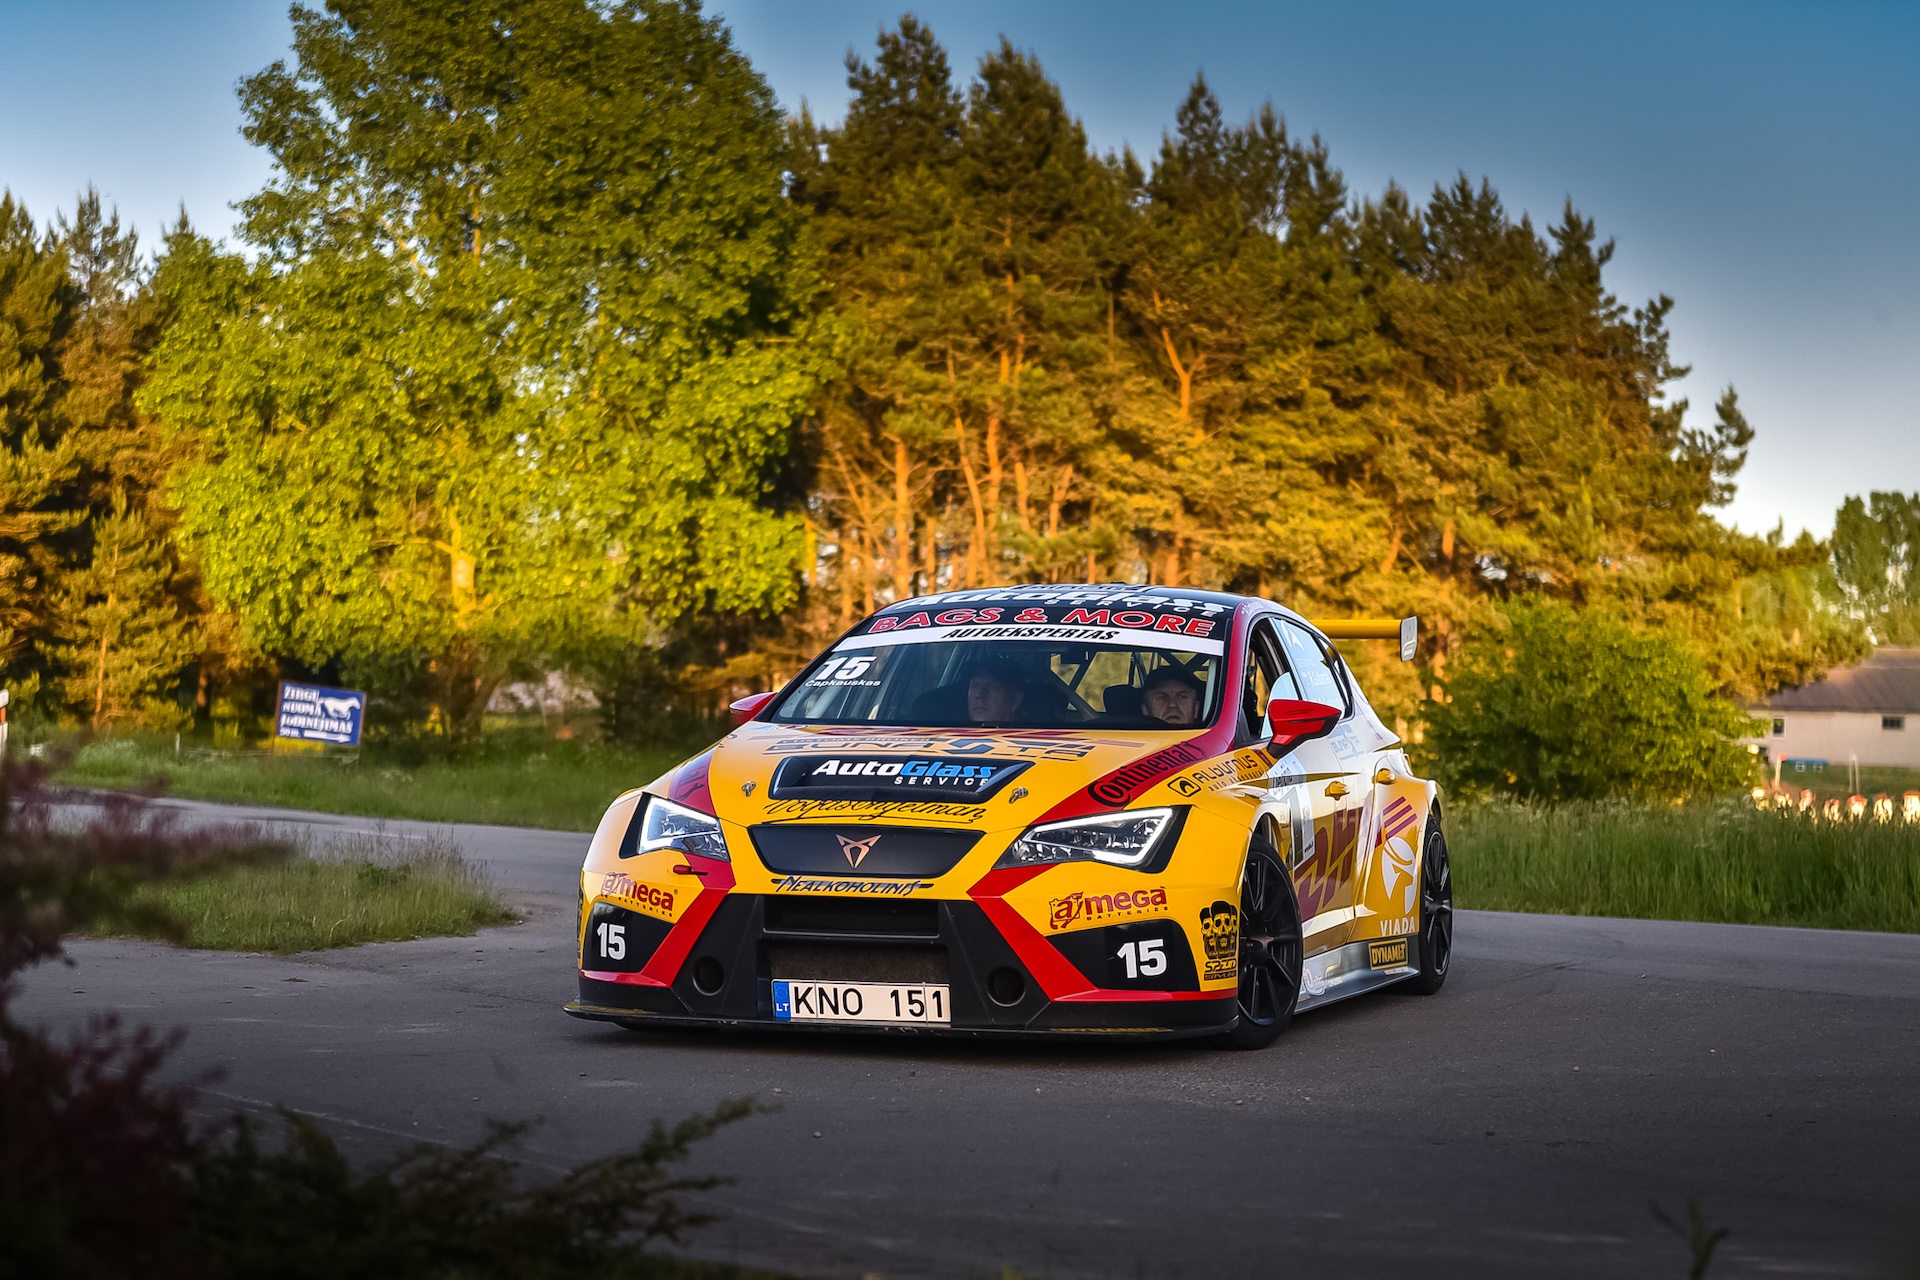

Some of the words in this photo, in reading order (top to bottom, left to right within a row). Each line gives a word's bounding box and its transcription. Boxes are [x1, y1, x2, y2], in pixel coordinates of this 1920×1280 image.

[895, 591, 1234, 613] AutoGlass
[1044, 599, 1219, 618] SERVICE
[870, 607, 1005, 634] BAGS
[1014, 607, 1048, 624] &
[1060, 608, 1216, 637] MORE
[940, 627, 1120, 640] AUTOEKSPERTAS
[814, 656, 878, 681] 15
[811, 760, 998, 778] AutoGlass
[1087, 742, 1198, 807] Continental
[893, 776, 990, 787] SERVICE
[1379, 916, 1416, 937] VIADA
[596, 922, 626, 961] 15
[1116, 939, 1168, 979] 15
[775, 1002, 790, 1013] LT
[793, 986, 864, 1017] KNO
[889, 988, 944, 1019] 151
